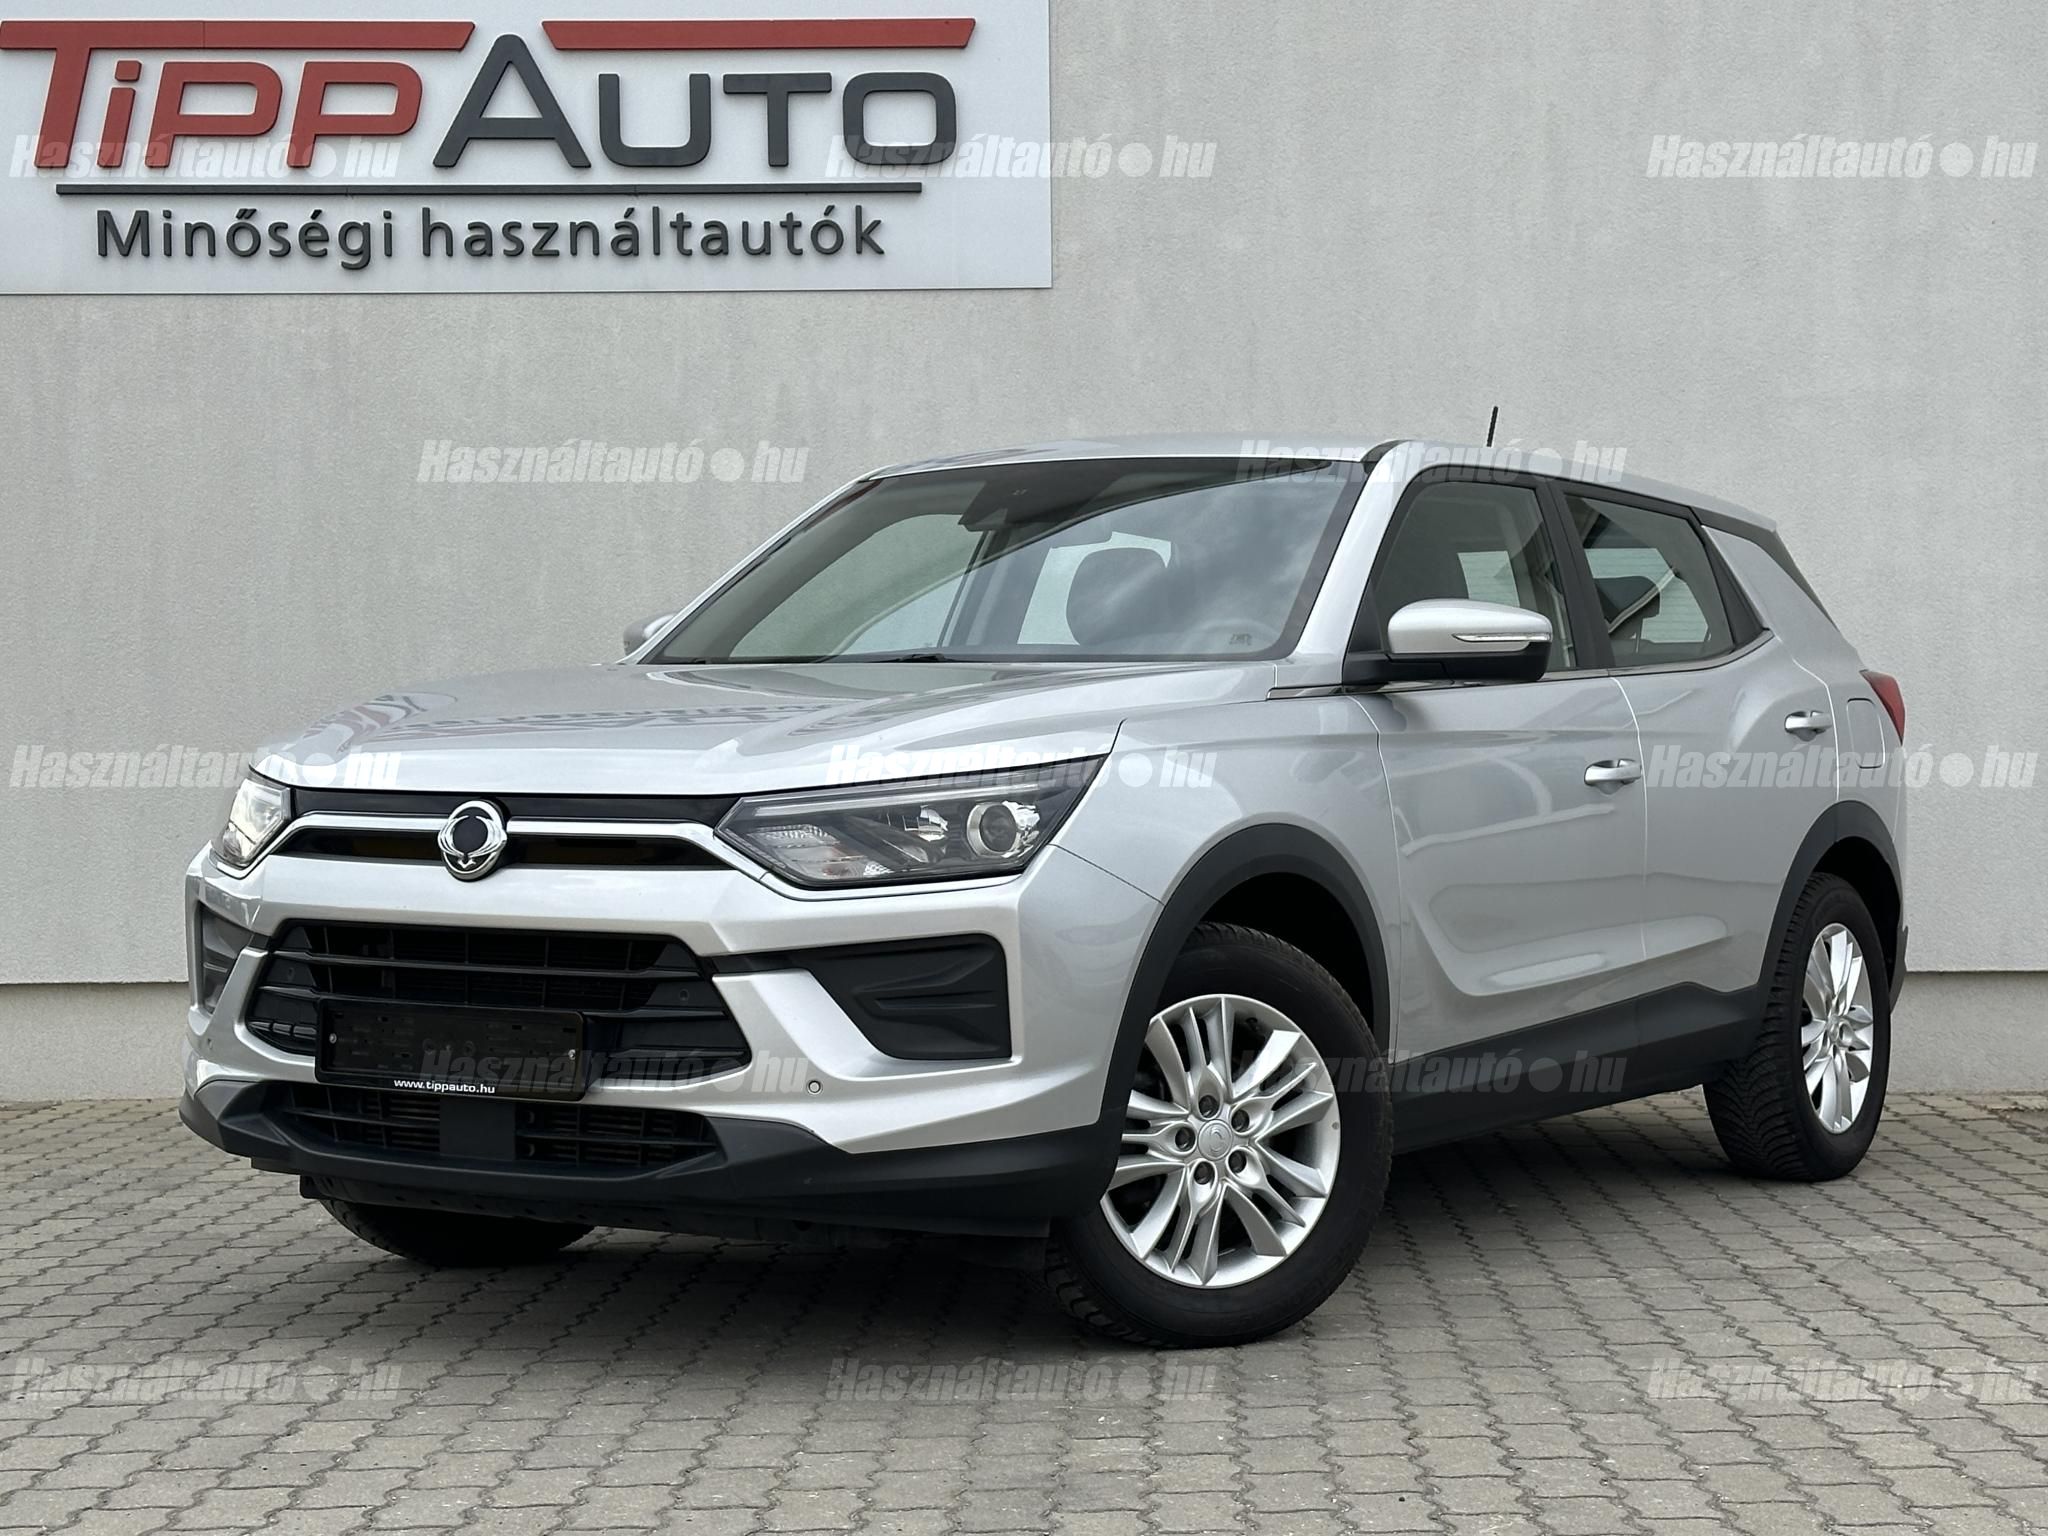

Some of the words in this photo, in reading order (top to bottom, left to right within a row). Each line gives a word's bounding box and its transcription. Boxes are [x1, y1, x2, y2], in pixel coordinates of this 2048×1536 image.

[97, 207, 394, 270] Minőségi
[422, 204, 885, 257] használtautók
[393, 1080, 496, 1094] www.tippauto.hu
